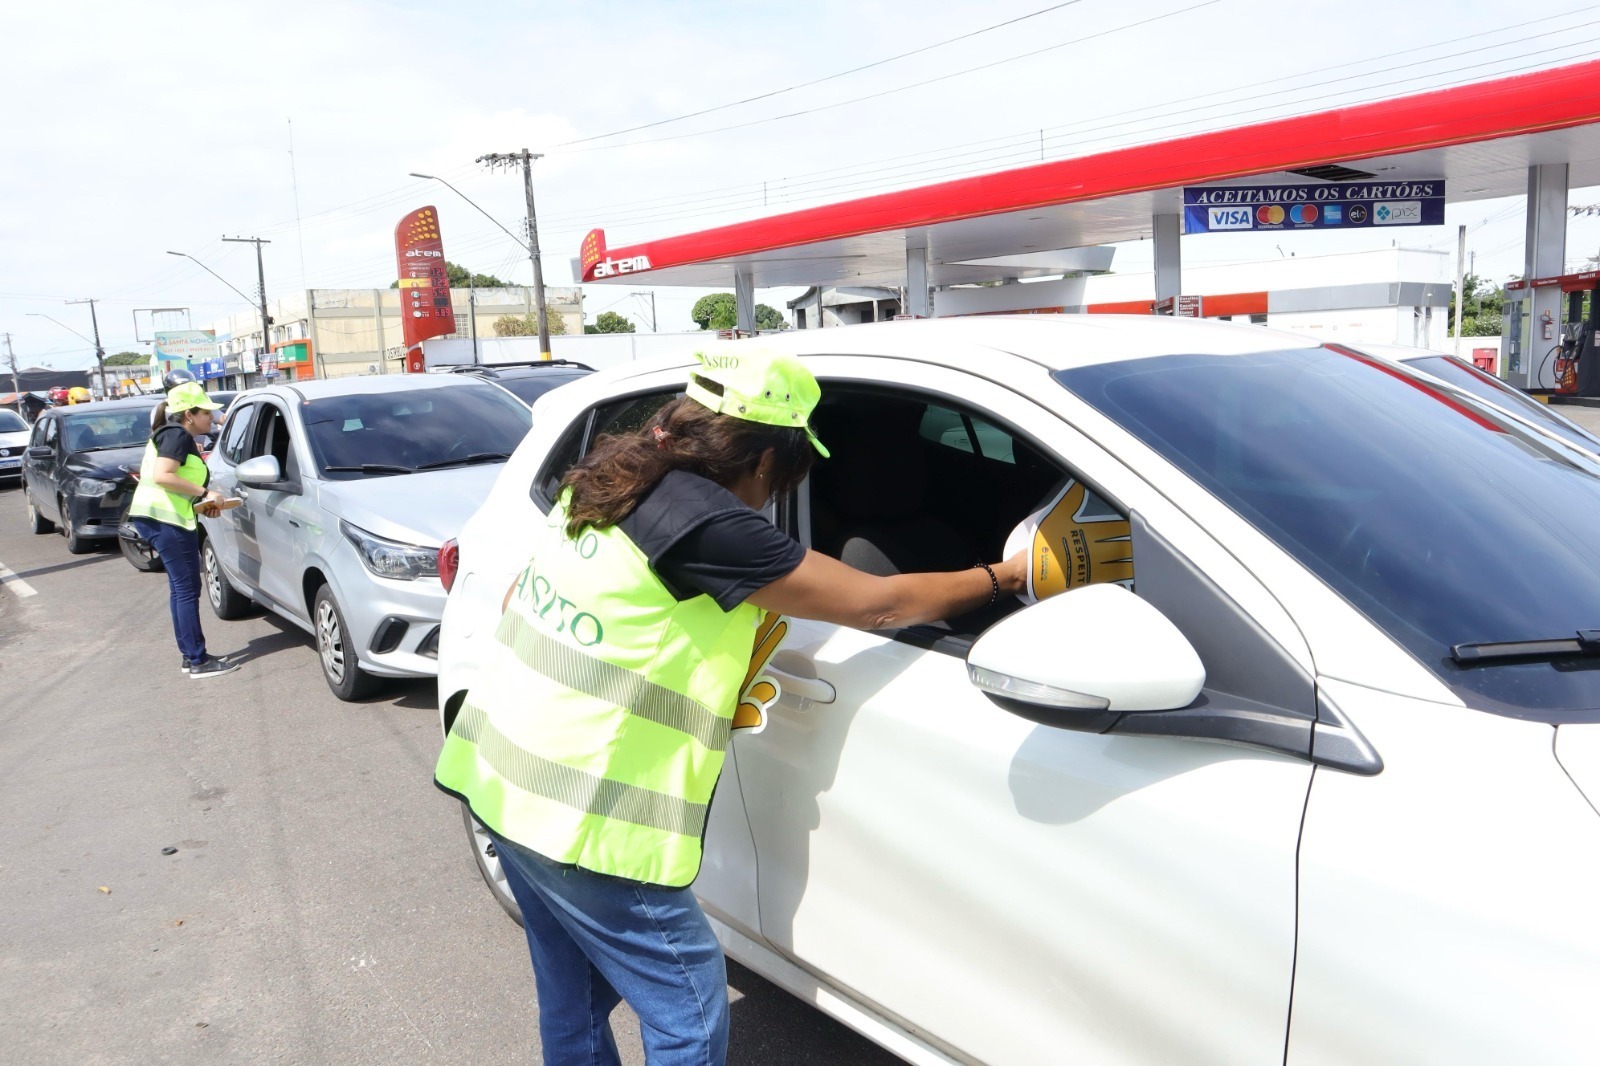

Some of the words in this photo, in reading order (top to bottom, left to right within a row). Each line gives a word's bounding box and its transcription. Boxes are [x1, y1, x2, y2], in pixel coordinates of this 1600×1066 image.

[1197, 188, 1308, 204] ACEITAMOS
[1314, 187, 1339, 200] OS
[1346, 182, 1434, 200] CARTÕES
[1213, 210, 1251, 226] VISA
[1391, 205, 1418, 221] pix
[405, 249, 442, 257] atem
[594, 255, 651, 278] atem
